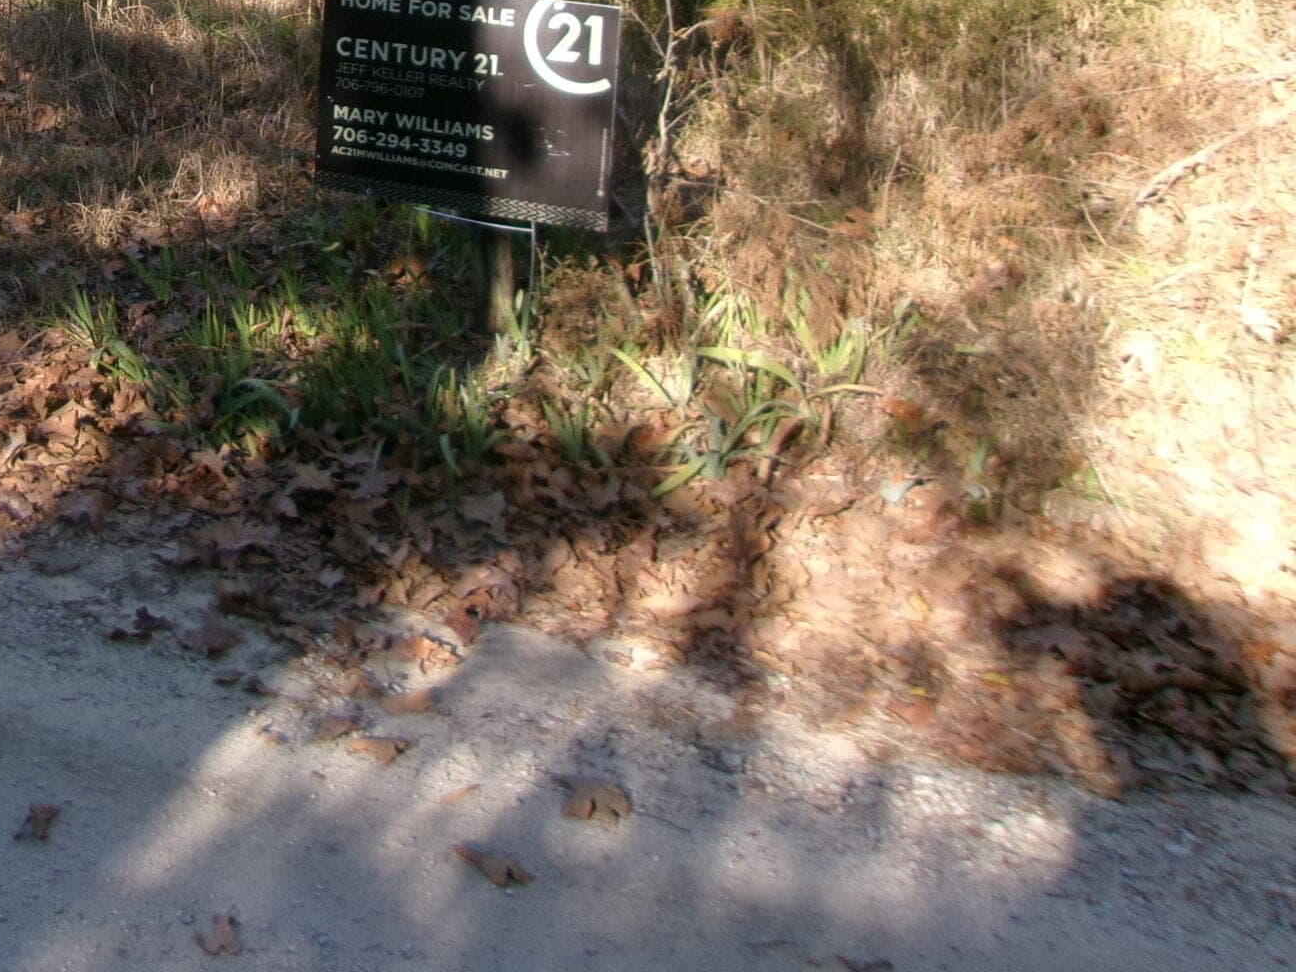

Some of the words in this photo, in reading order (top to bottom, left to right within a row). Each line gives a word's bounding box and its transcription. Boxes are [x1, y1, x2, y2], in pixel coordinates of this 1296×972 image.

[408, 0, 452, 19] FOR
[459, 4, 515, 27] SALE
[336, 36, 467, 70] CENTURY
[336, 61, 368, 76] JEFF
[372, 67, 424, 84] KELLER
[429, 73, 485, 91] REALTY
[333, 104, 390, 126] MARY
[395, 113, 494, 141] WILLIAMS
[332, 125, 467, 158] 706-294-3349
